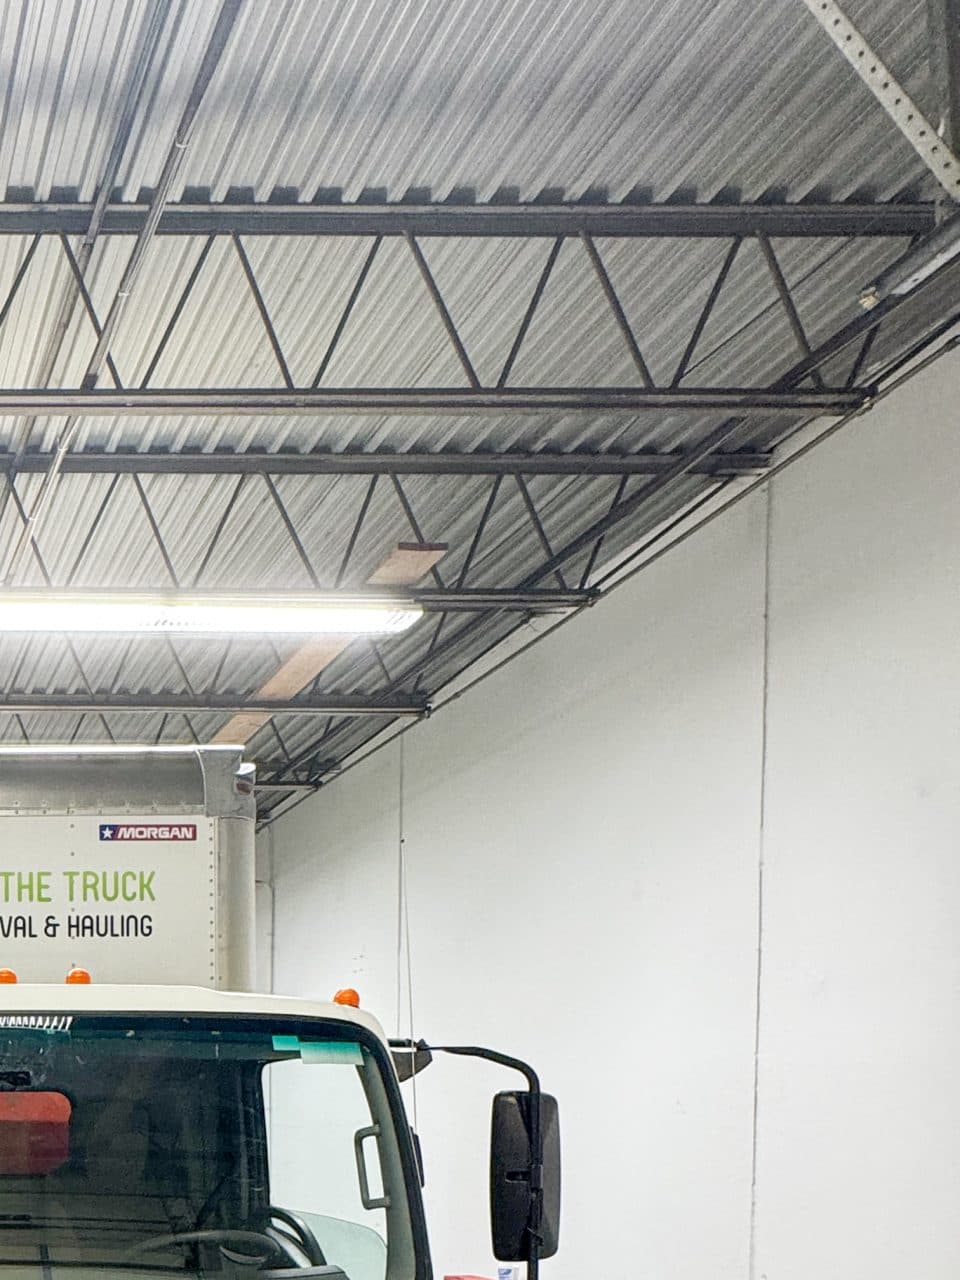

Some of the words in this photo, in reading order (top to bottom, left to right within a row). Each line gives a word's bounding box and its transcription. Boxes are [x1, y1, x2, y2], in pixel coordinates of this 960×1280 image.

[117, 827, 193, 839] MORGAN
[62, 870, 156, 902] TRUCK
[44, 915, 60, 938] &
[68, 914, 152, 937] HAULING
